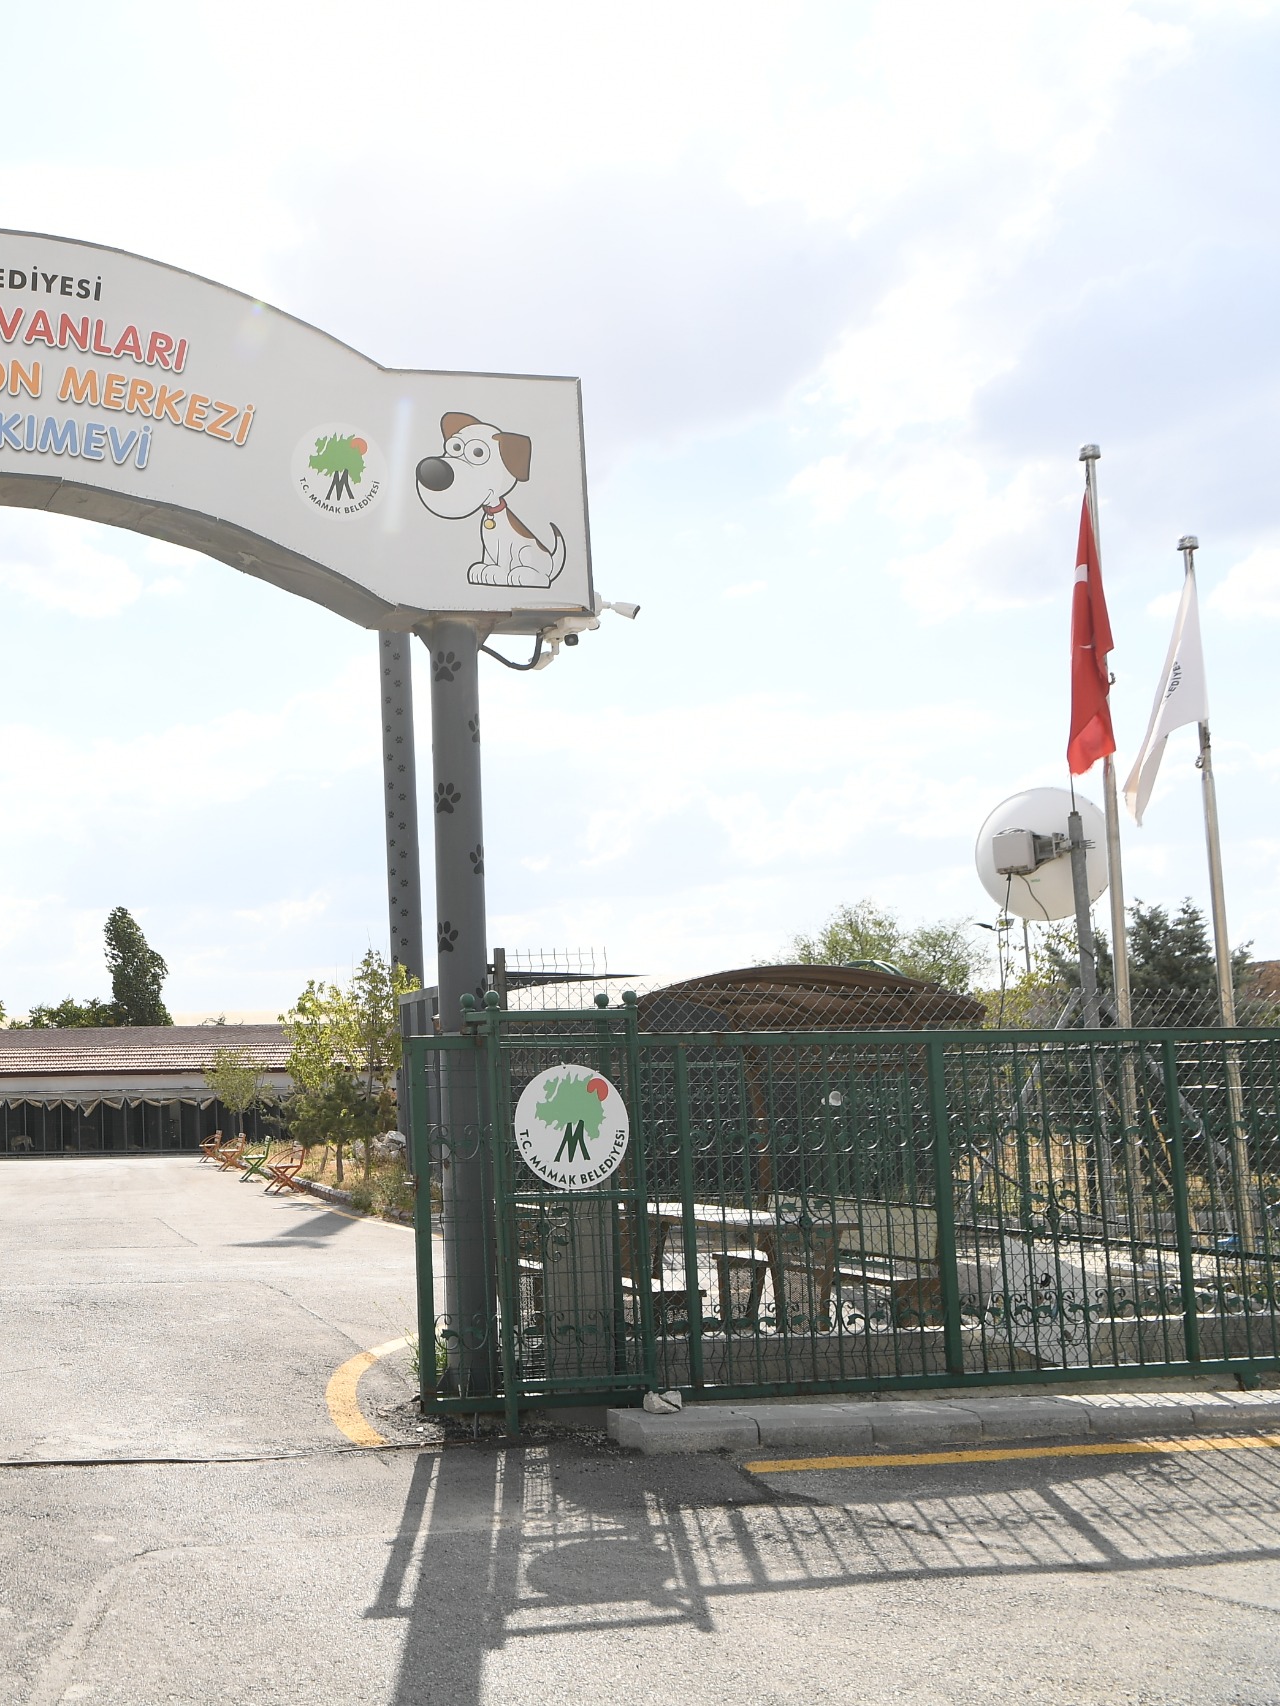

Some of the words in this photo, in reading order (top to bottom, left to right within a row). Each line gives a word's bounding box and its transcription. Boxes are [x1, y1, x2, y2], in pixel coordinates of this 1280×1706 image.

[58, 367, 255, 447] MERKEZİ
[299, 477, 310, 494] T.C.
[309, 494, 341, 514] MAMAK
[344, 480, 380, 514] BELEDİYESİ
[519, 1129, 532, 1154] T.C.
[529, 1155, 576, 1185] MAMAK
[580, 1129, 625, 1184] BELEDİYESİ
